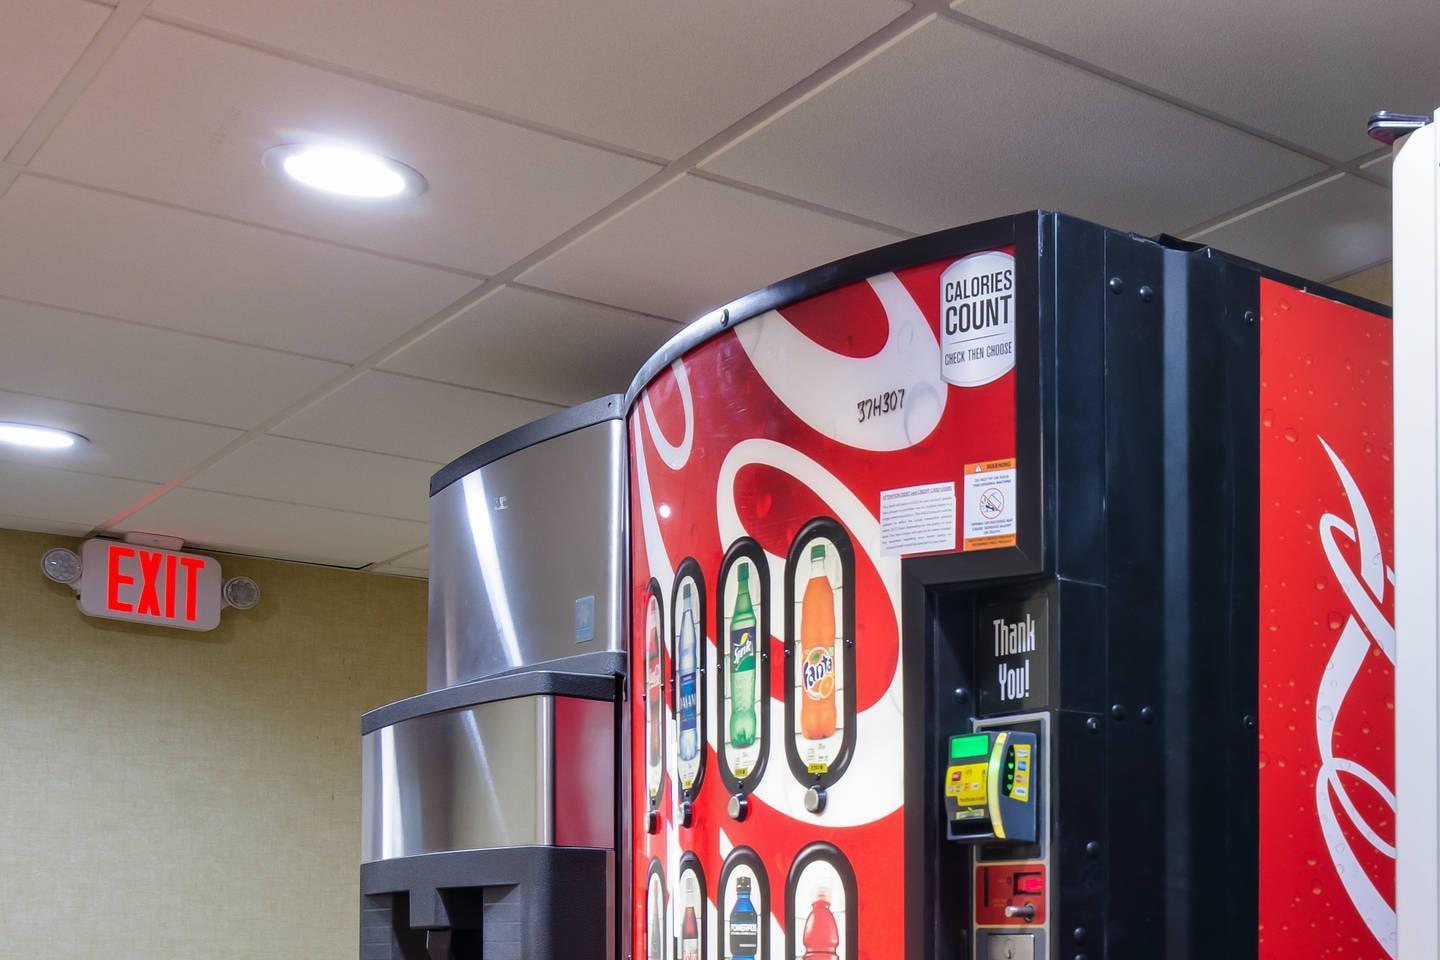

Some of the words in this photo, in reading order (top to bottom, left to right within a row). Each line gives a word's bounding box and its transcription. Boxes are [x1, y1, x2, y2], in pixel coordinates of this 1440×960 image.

[945, 270, 1012, 303] CALORIES
[945, 294, 1012, 335] COUNT
[945, 350, 965, 365] CHECK
[968, 346, 984, 360] THEN
[987, 342, 1012, 358] CHOOSE
[857, 388, 905, 423] 37H307
[107, 544, 205, 622] EXIT
[993, 613, 1036, 657] Thank
[999, 659, 1030, 701] You!
